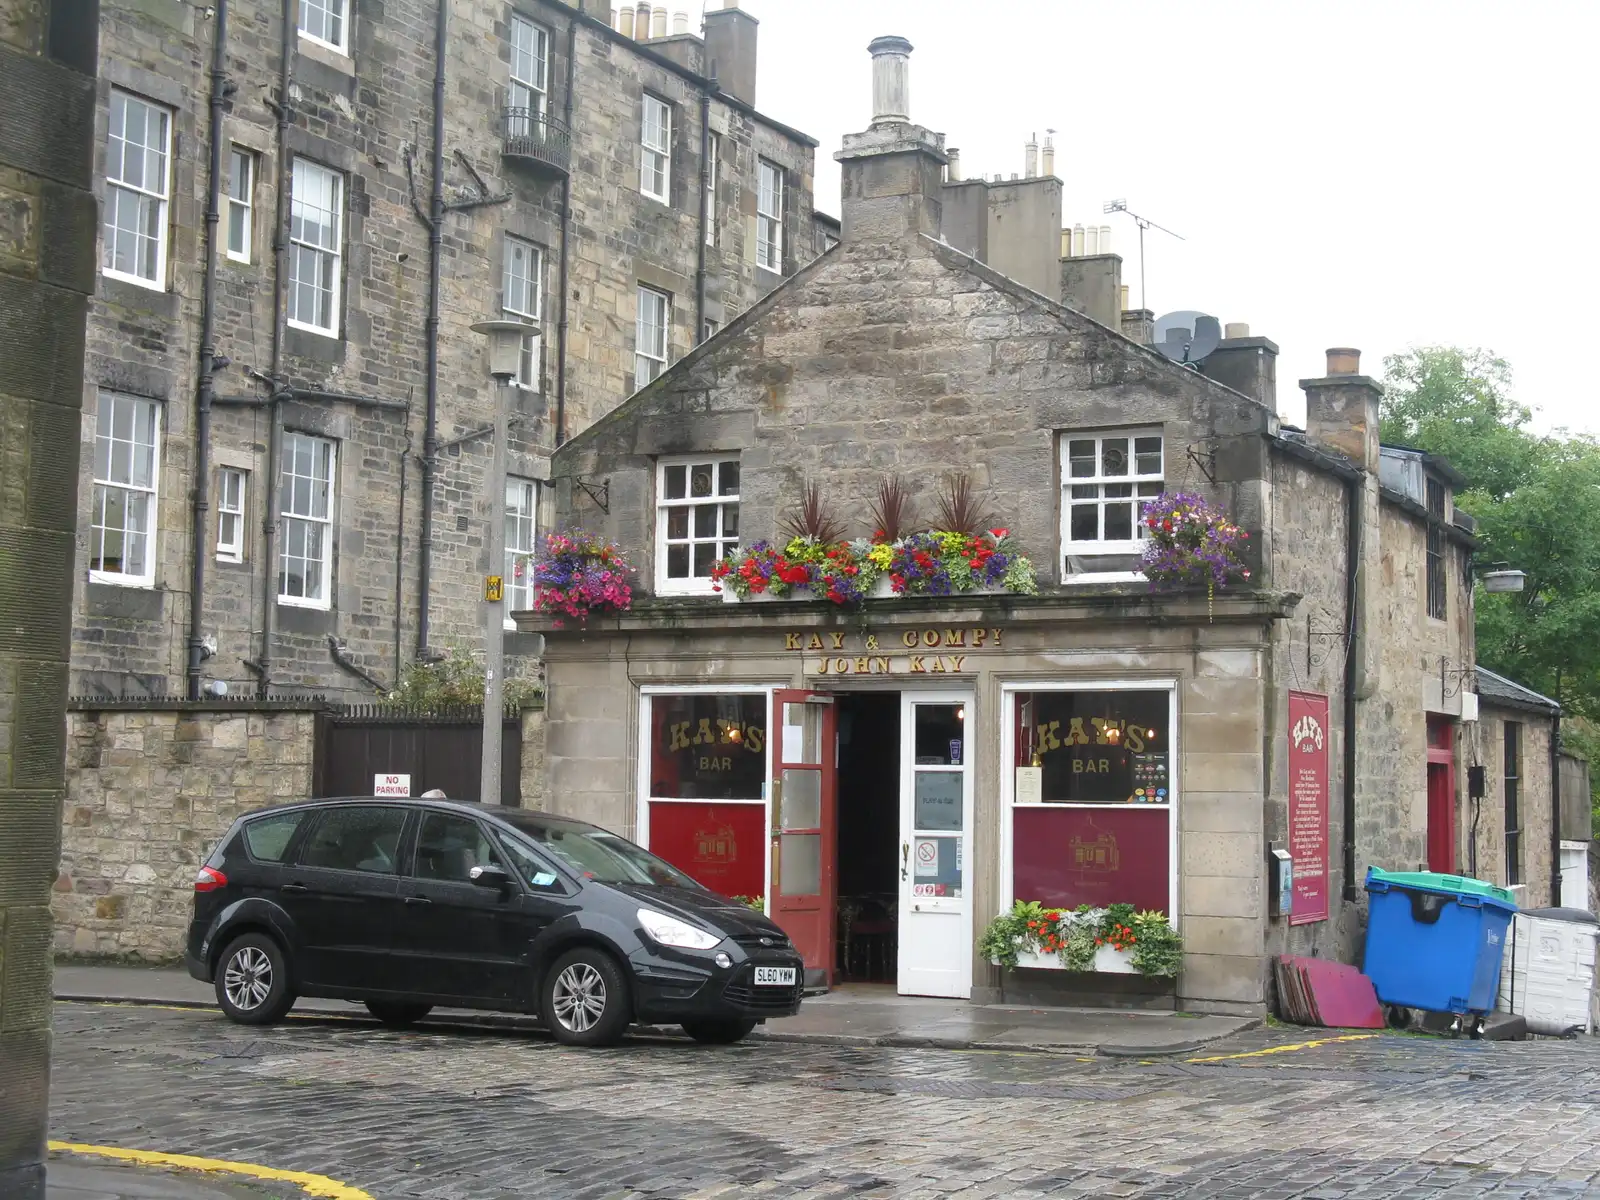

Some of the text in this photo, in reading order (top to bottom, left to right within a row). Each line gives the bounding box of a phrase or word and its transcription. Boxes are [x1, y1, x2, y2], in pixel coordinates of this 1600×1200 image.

[786, 631, 845, 650] KAY
[865, 634, 879, 650] &
[817, 655, 968, 675] JOHN KAY
[669, 717, 765, 754] KAY'S
[1036, 716, 1147, 755] KAY'S
[1302, 743, 1314, 754] BAR
[699, 756, 733, 771] BAR
[1072, 758, 1111, 774] BAR
[386, 776, 399, 784] NO
[376, 786, 408, 794] PARKING
